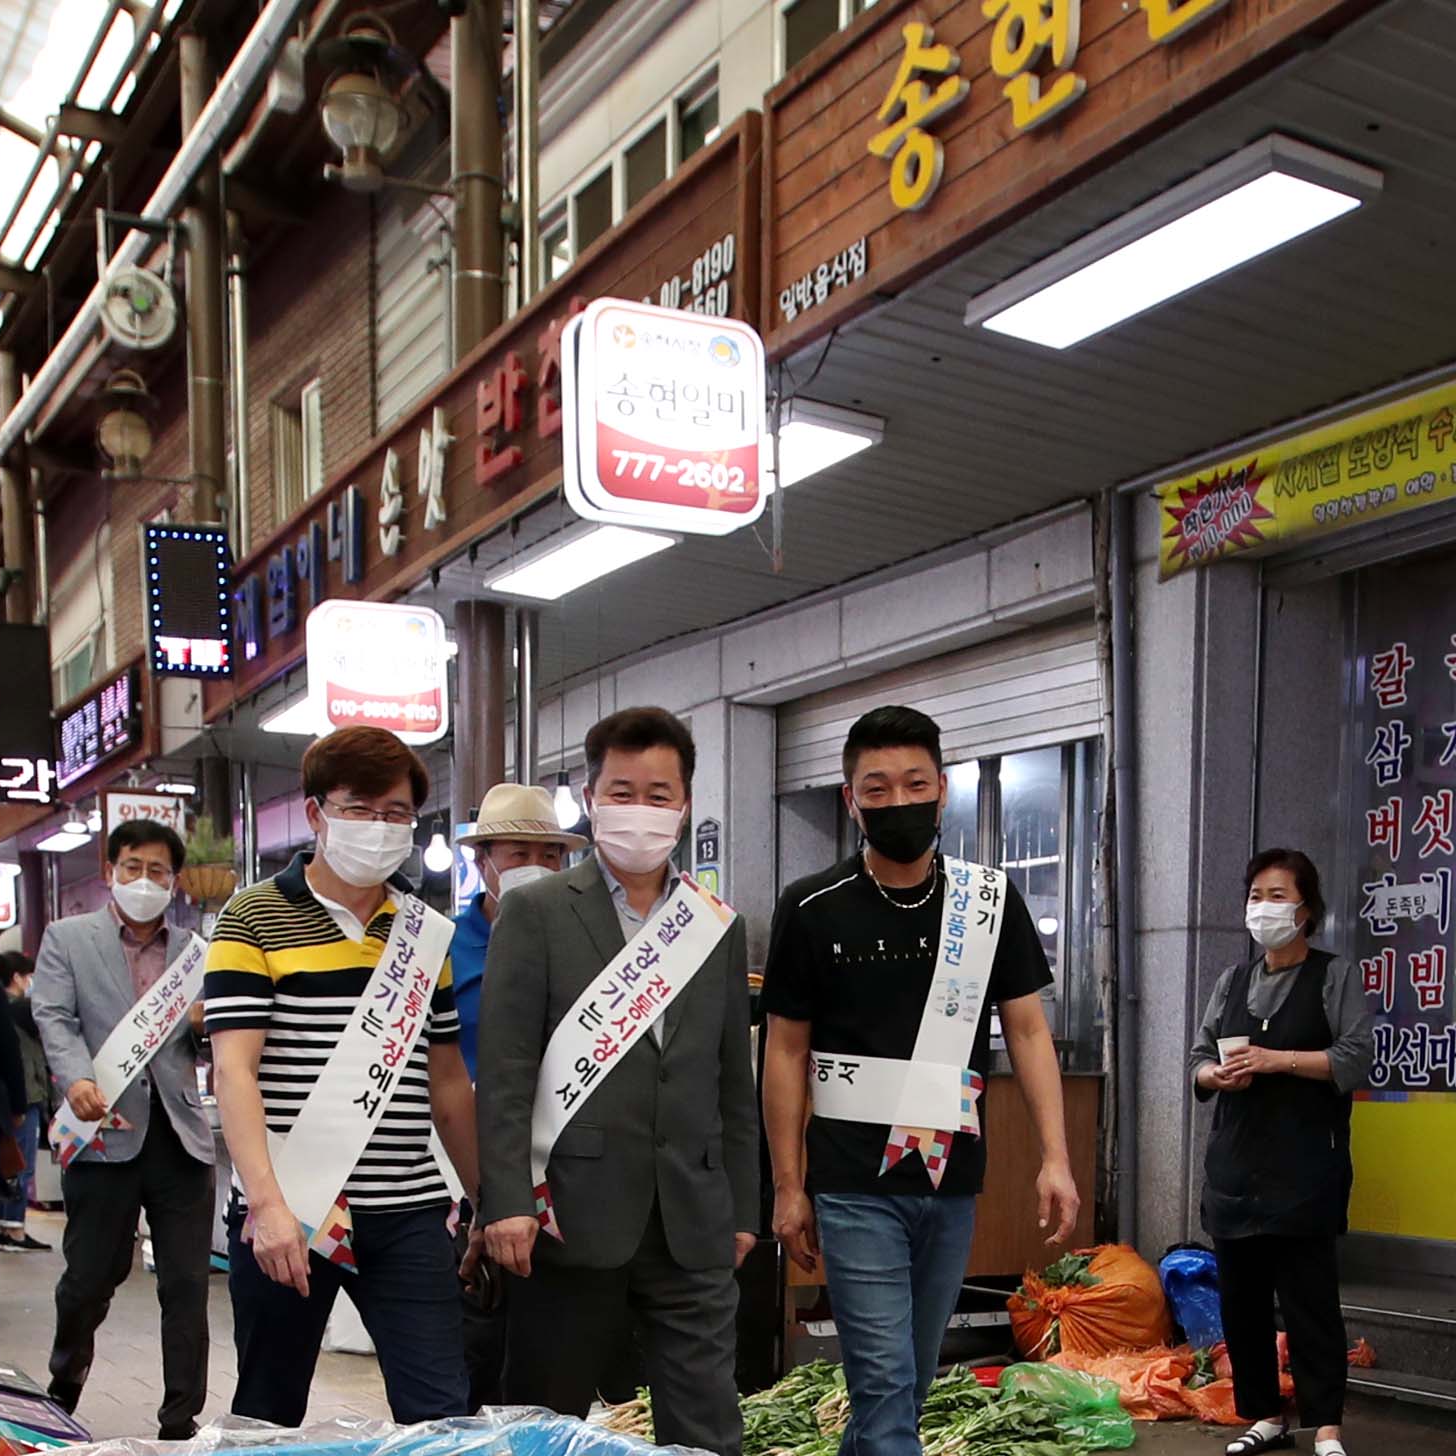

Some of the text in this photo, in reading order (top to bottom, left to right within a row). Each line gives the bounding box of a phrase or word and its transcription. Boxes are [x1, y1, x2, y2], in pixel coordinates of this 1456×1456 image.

[867, 0, 1234, 209] 송현
[779, 238, 867, 321] 일반음식점
[607, 372, 747, 433] 송현일미
[611, 449, 746, 494] 777-2602
[1348, 415, 1423, 479] 보양식
[702, 840, 714, 859] 13
[360, 936, 415, 1038] 장보기는
[578, 900, 694, 1032] 명절 장보기는
[117, 992, 187, 1078] 전통시장에서
[353, 967, 432, 1120] 전통시장에서
[555, 973, 672, 1111] 전통시장에서
[811, 1057, 861, 1086] 에서
